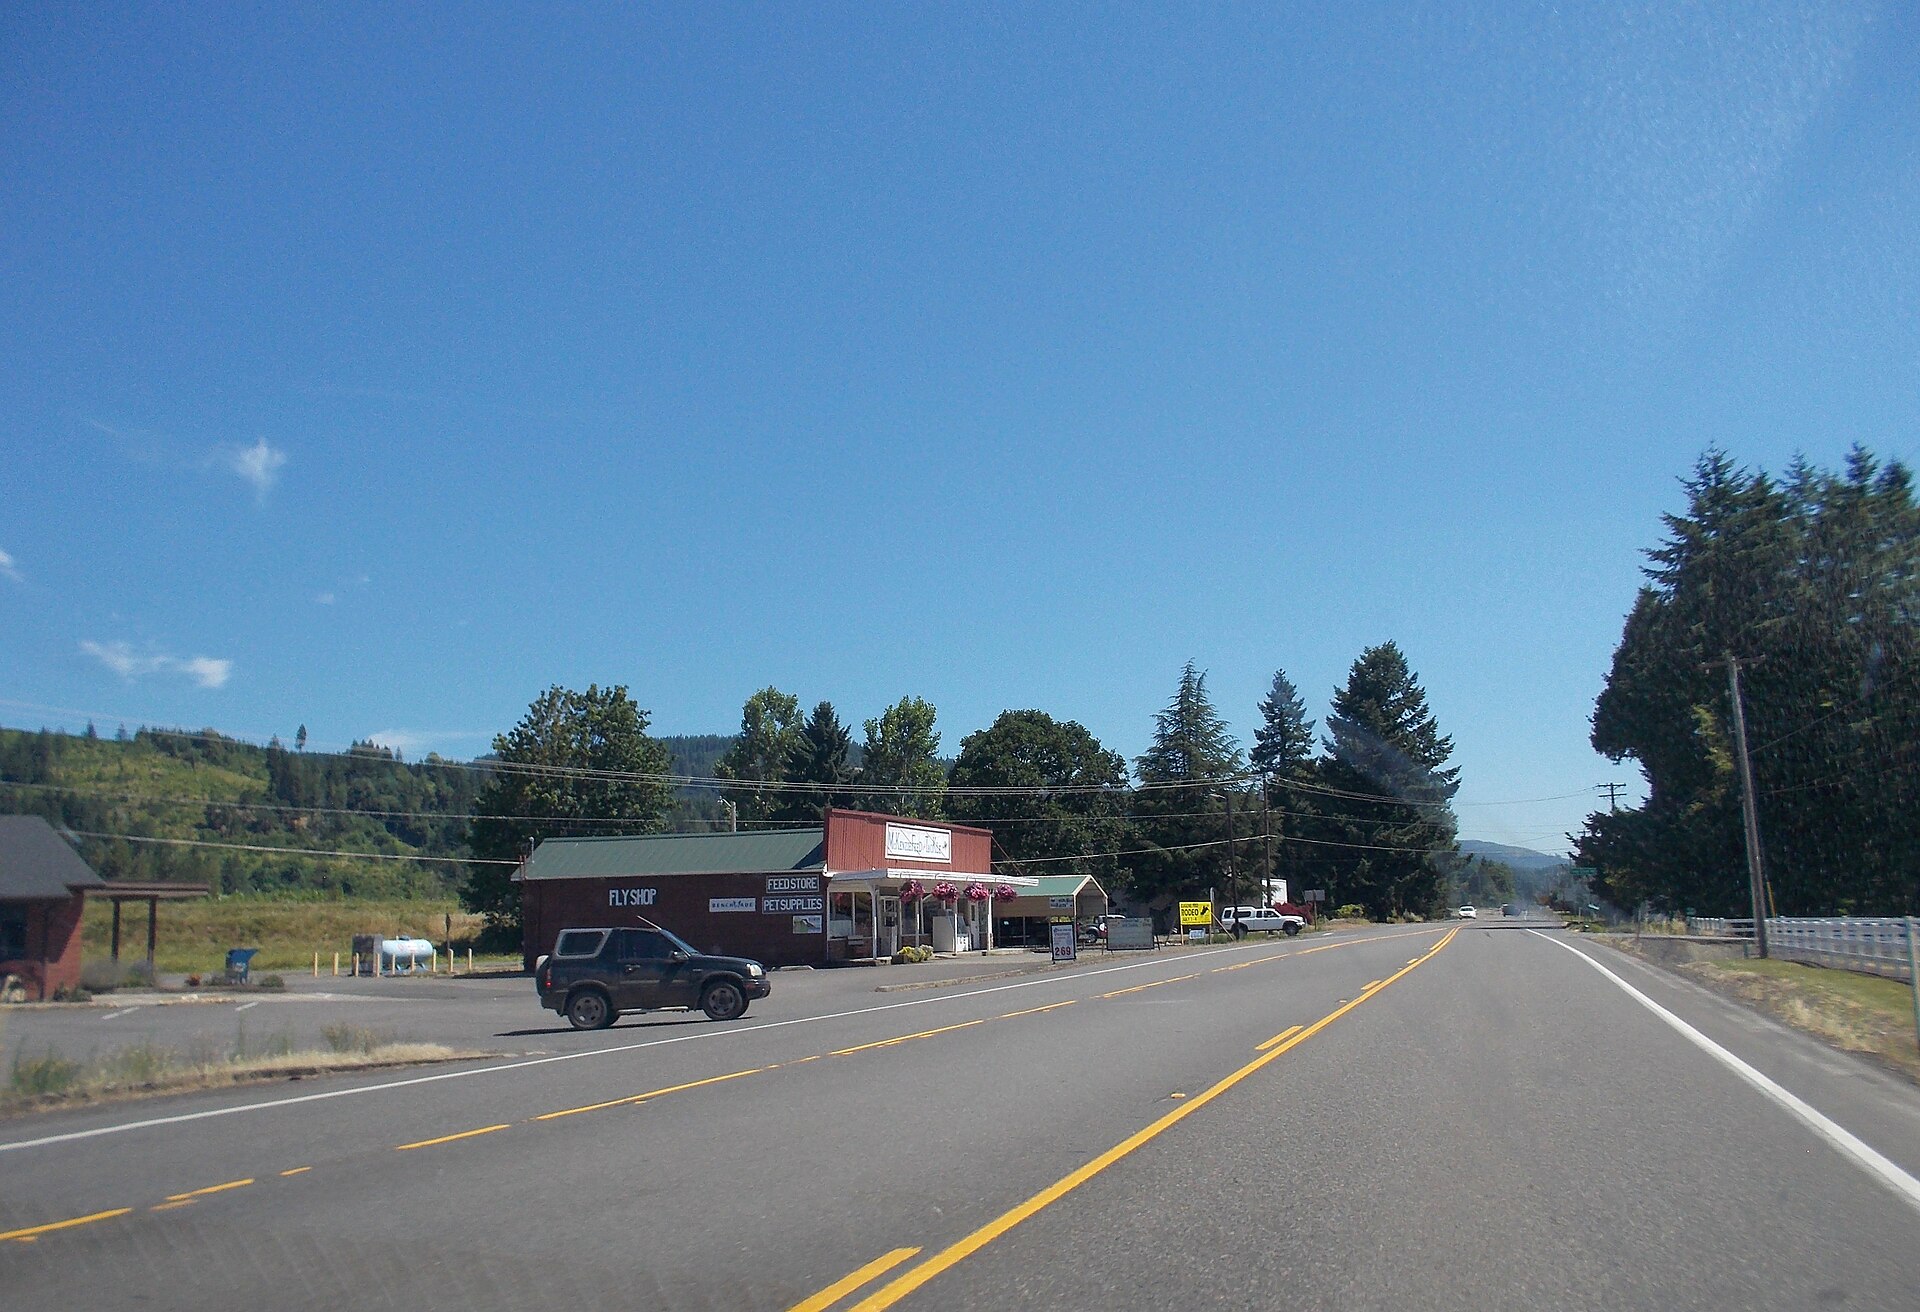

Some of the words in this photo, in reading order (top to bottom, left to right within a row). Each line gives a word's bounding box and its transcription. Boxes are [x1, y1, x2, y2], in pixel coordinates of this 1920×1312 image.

[768, 879, 790, 890] FEED
[790, 878, 818, 889] STORE
[609, 889, 630, 906] FLY
[630, 888, 657, 905] SHOP
[763, 899, 780, 911] PET
[780, 898, 823, 911] SUPPLIES
[1181, 908, 1199, 916] RODEO
[1055, 946, 1071, 956] 269
